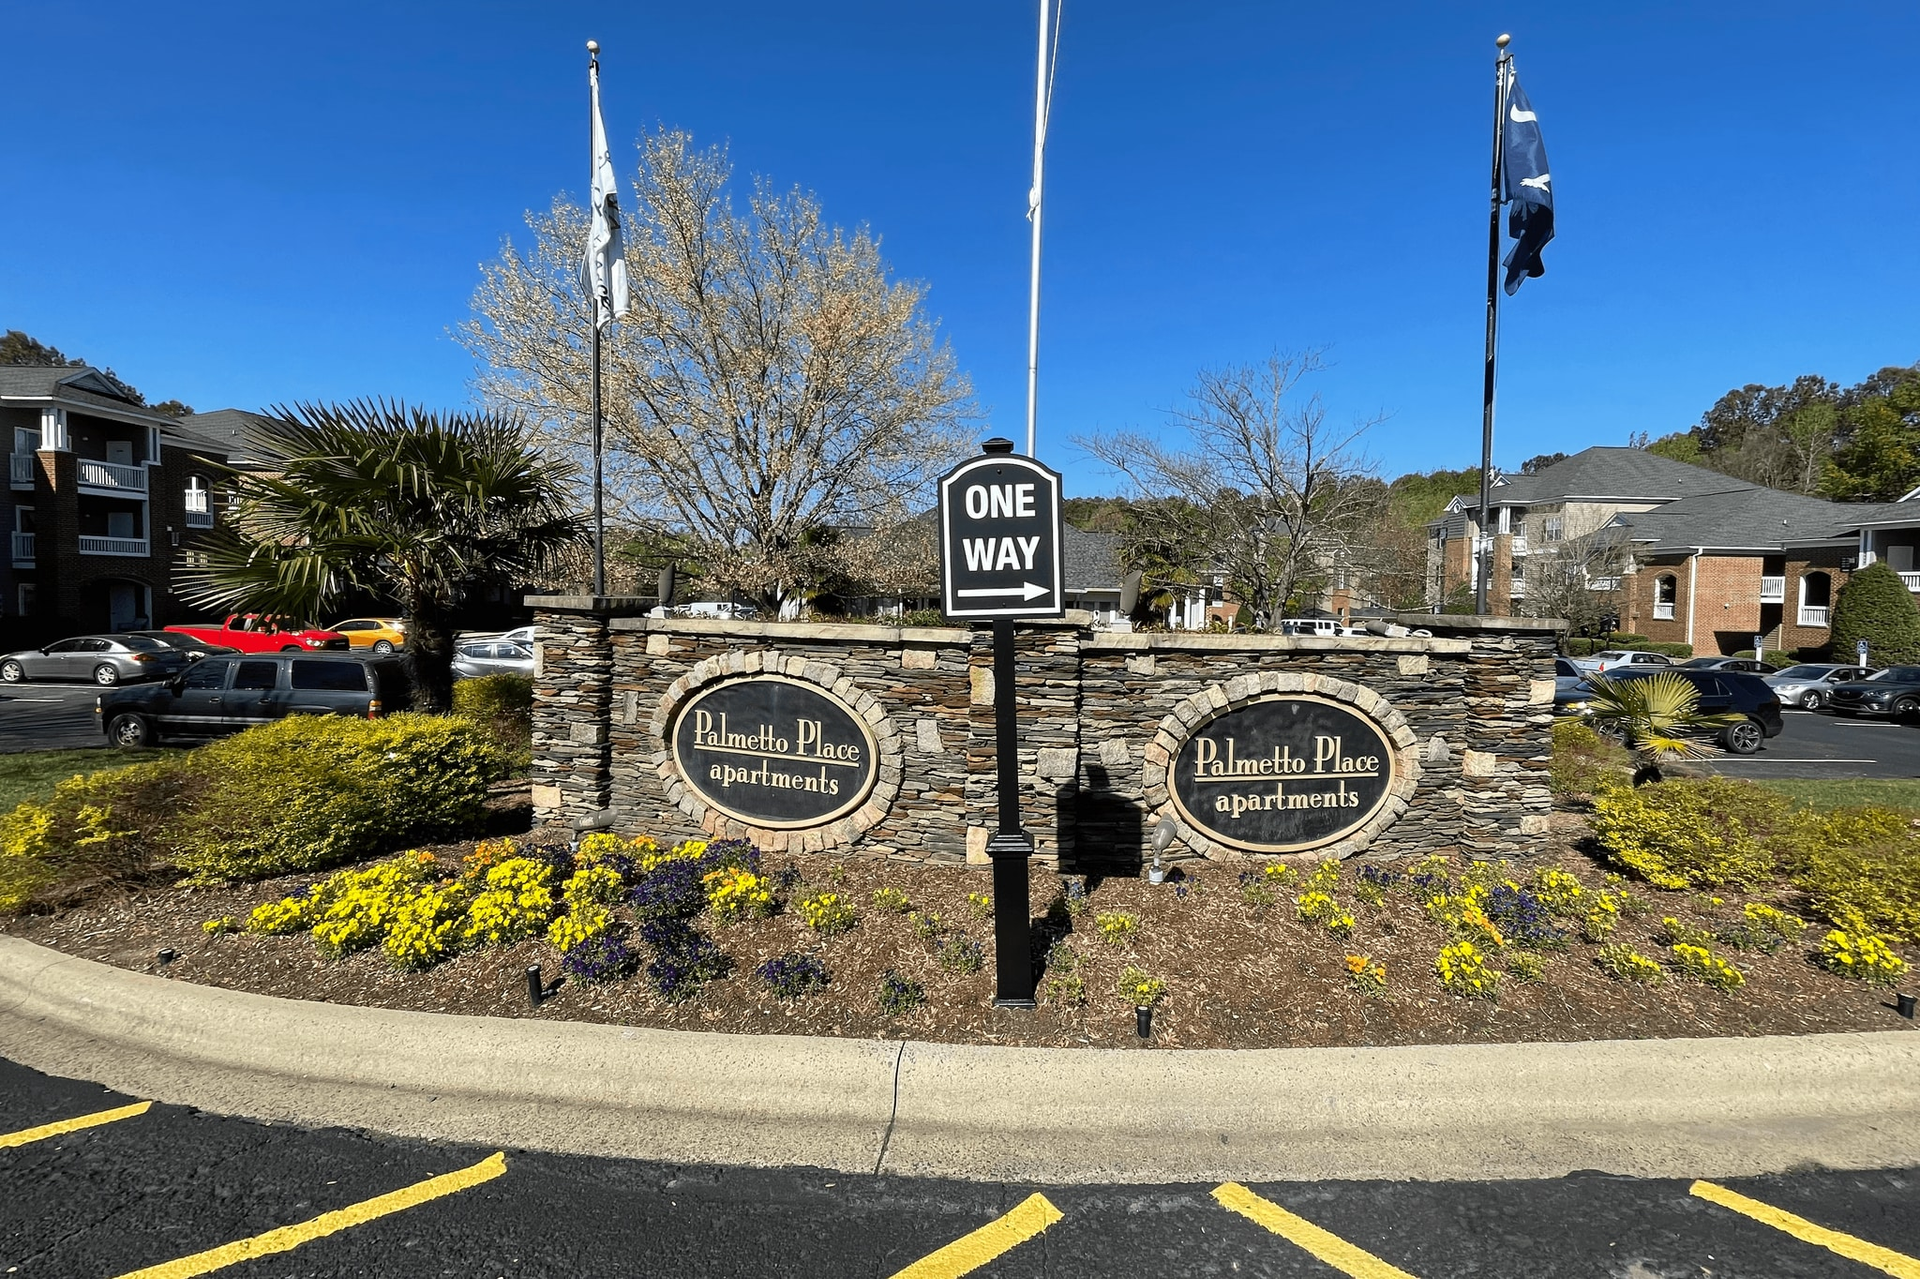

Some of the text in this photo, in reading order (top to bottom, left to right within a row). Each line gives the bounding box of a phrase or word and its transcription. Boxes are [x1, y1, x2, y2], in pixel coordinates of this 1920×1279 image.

[965, 483, 1036, 520] ONE
[962, 536, 1041, 572] WAY
[694, 709, 860, 760] Palmetto Place
[1194, 735, 1379, 777] Palmetto Place
[709, 759, 839, 795] apartments
[1215, 780, 1359, 818] apartments
